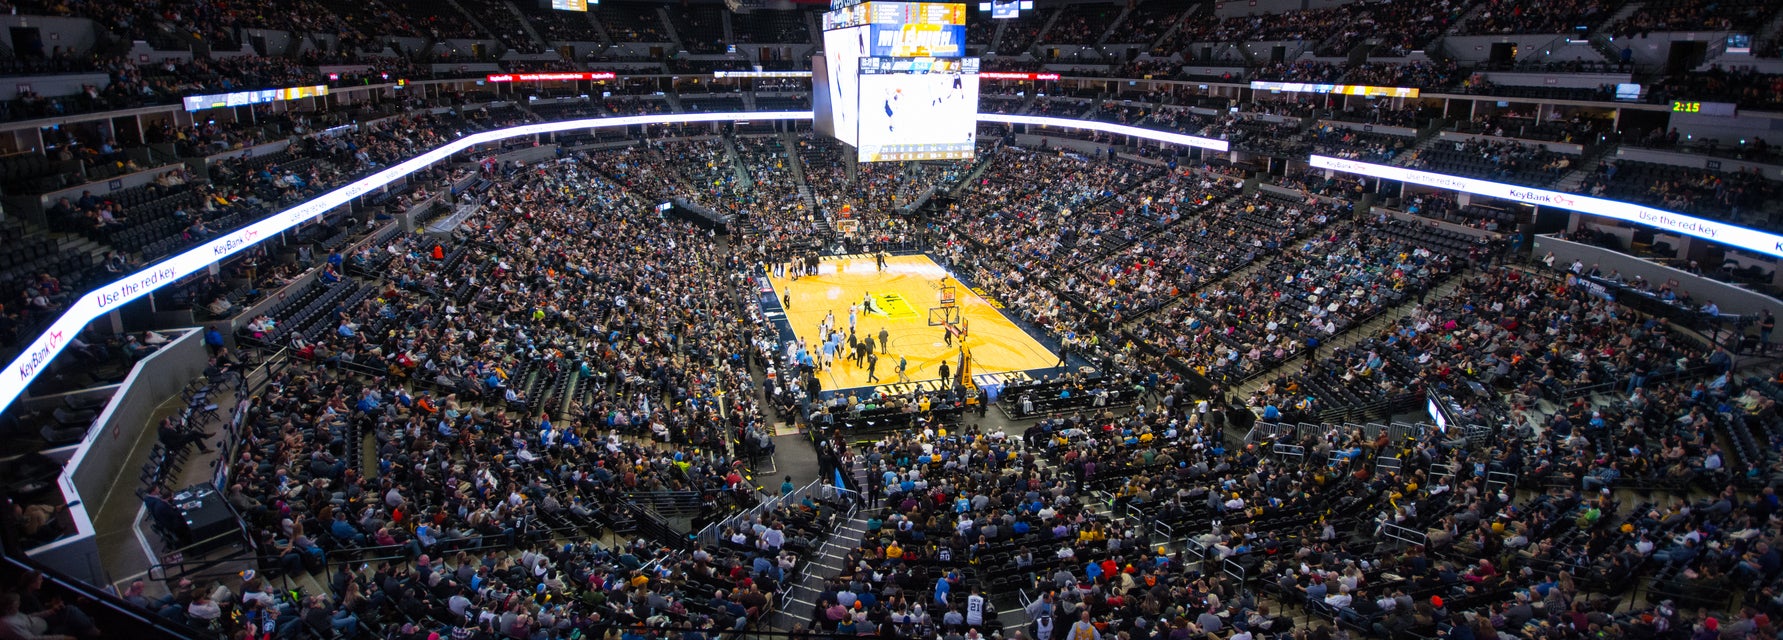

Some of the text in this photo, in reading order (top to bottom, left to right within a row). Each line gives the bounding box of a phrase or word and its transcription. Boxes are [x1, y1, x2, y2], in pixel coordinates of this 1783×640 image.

[1673, 101, 1700, 112] 2:15
[1437, 177, 1450, 186] red
[1509, 188, 1551, 204] KeyBank
[1639, 210, 1658, 223] Use
[1659, 214, 1677, 227] the
[1678, 219, 1697, 232] red
[213, 236, 244, 255] KeyBank
[97, 291, 119, 308] Use
[121, 282, 139, 297] the
[141, 271, 158, 289] red
[19, 342, 50, 381] KeyBank
[970, 602, 980, 612] 21
